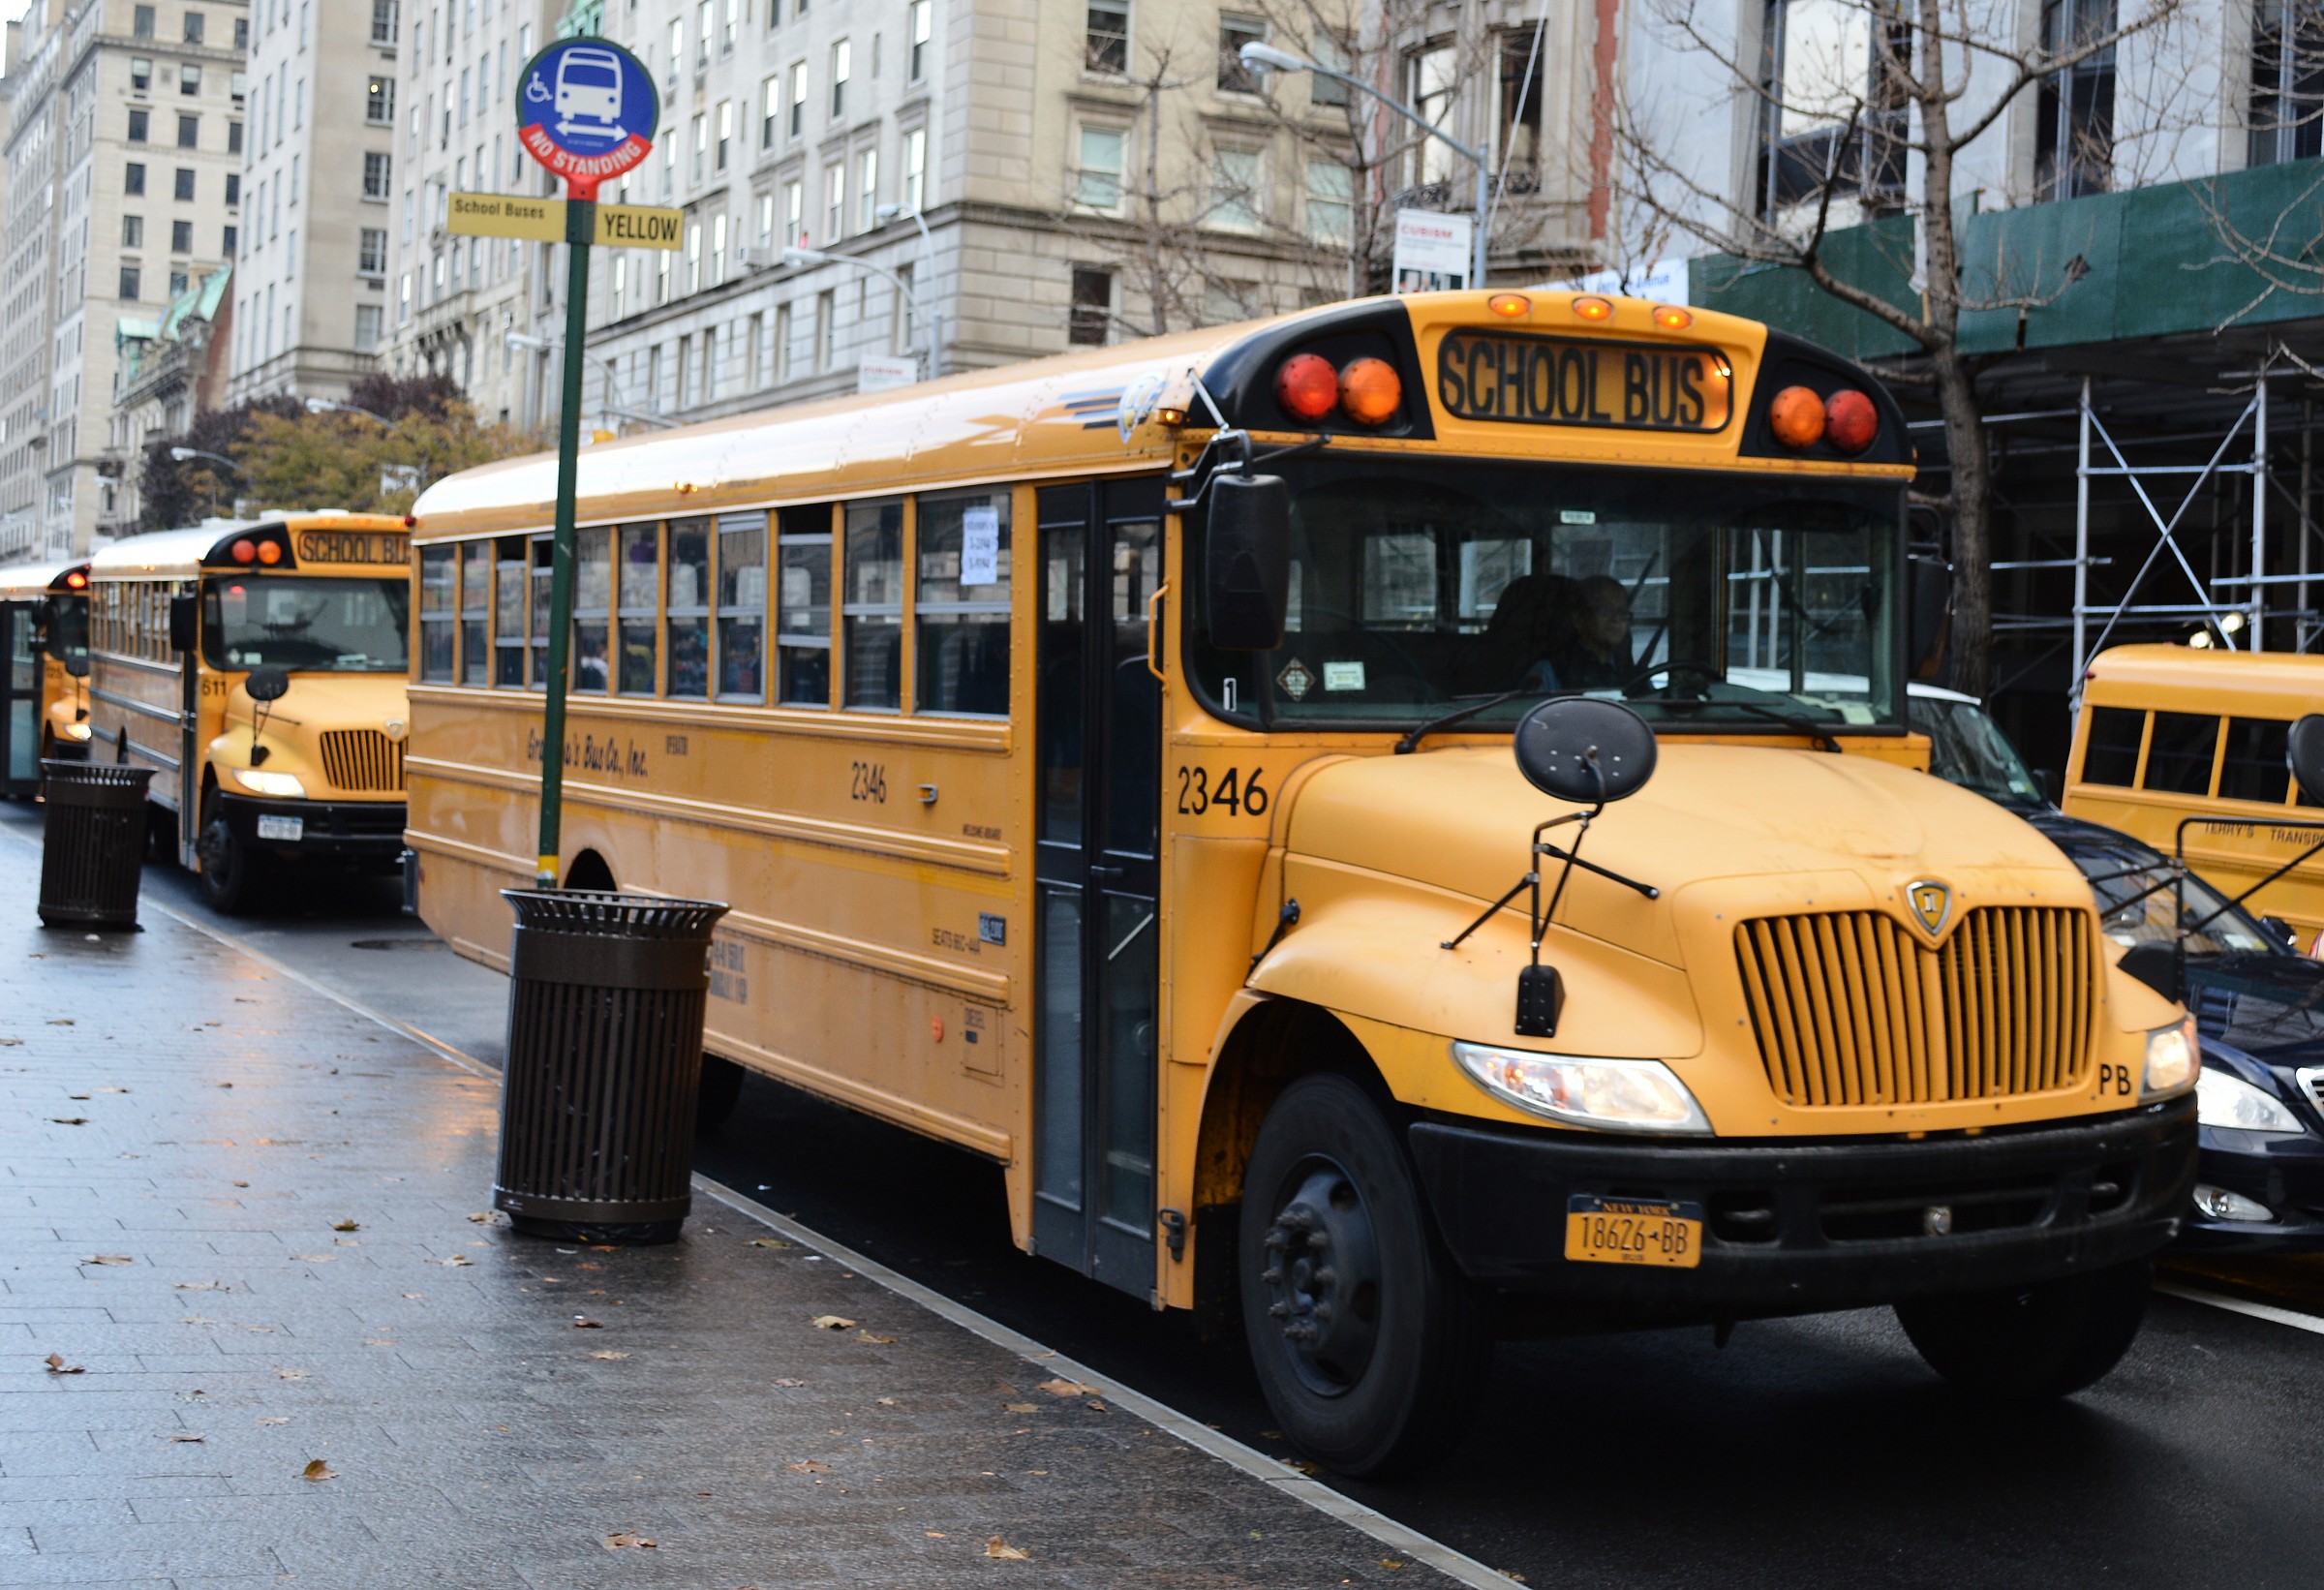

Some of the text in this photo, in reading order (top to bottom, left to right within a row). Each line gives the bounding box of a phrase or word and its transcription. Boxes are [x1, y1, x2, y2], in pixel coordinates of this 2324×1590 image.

[528, 131, 643, 175] NO STANDING
[455, 199, 545, 220] School Buses
[604, 212, 678, 242] YELLOW
[1440, 338, 1705, 428] SCHOOL BUS
[303, 534, 383, 563] SCHOOL
[584, 734, 605, 771] Bus
[852, 761, 887, 804] 2346
[1178, 766, 1268, 816] 2346
[2099, 1063, 2131, 1095] PB
[1603, 1202, 1671, 1217] NEW YORK
